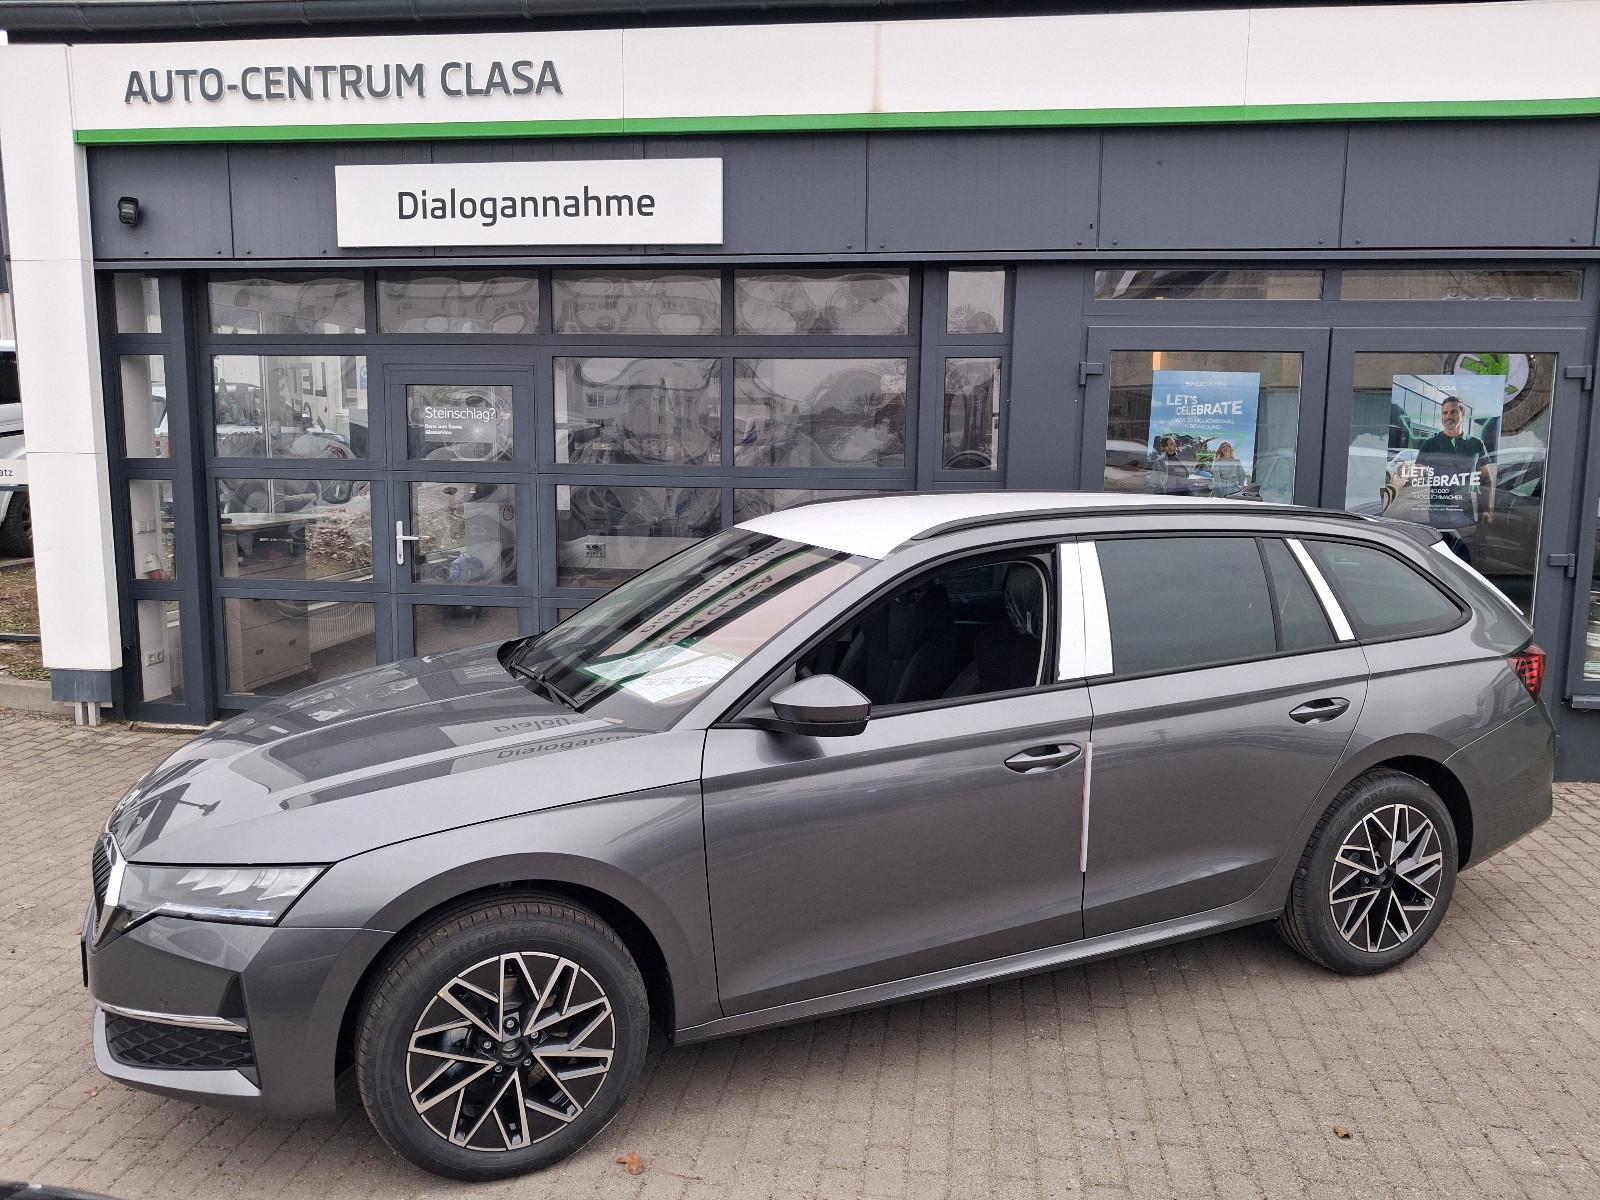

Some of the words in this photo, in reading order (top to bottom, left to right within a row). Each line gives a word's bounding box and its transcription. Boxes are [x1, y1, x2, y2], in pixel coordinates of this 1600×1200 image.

[124, 62, 426, 105] AUTO-CENTRUM
[440, 60, 563, 98] CLASA
[397, 185, 656, 228] Dialogannahme
[1166, 393, 1198, 406] LET'S
[1176, 400, 1242, 415] CELEBRATE
[425, 406, 496, 423] Steinschlag?
[1401, 465, 1435, 478] LET'S
[1411, 471, 1481, 487] CELEBRATE
